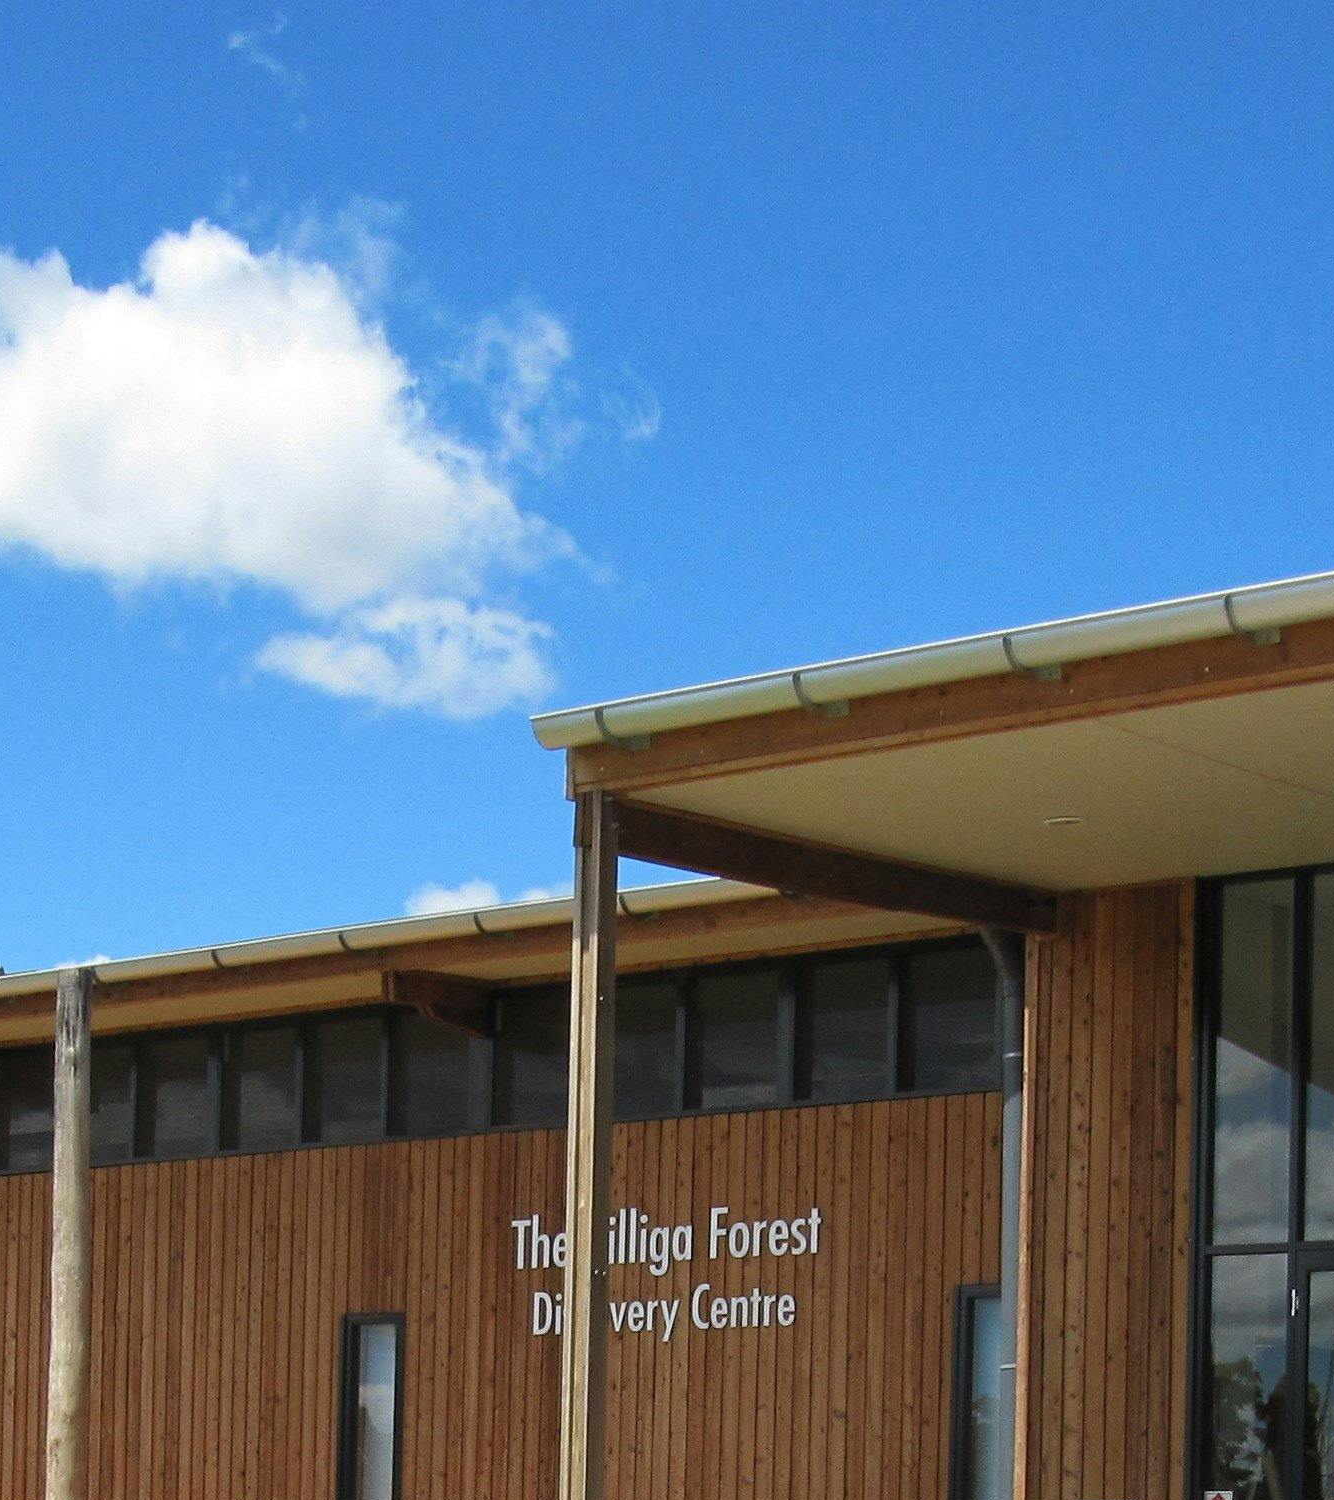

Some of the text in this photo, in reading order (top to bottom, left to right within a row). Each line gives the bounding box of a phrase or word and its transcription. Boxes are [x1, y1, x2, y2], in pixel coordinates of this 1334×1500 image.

[511, 1206, 822, 1277] The illiga Forest
[532, 1283, 797, 1343] Divery Centre
